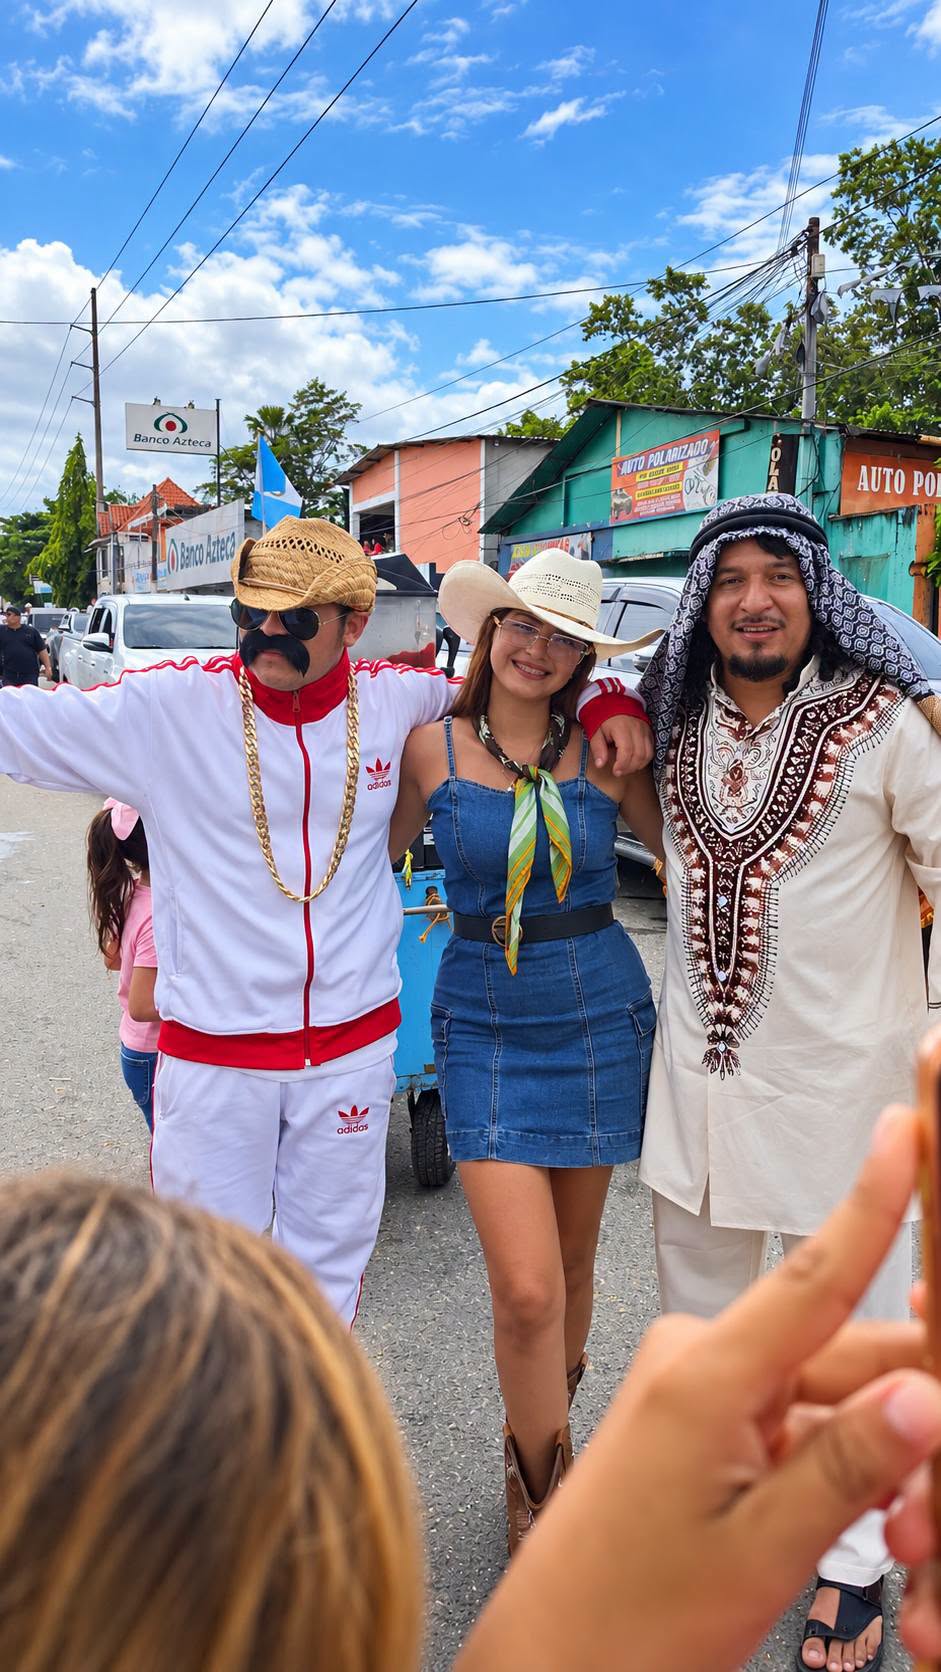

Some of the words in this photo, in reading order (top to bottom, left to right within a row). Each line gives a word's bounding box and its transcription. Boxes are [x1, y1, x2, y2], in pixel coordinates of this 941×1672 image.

[133, 433, 170, 445] Banco
[173, 436, 212, 448] Azteca
[620, 455, 646, 476] AUTO
[647, 438, 709, 469] POLARIZADO
[857, 464, 906, 495] AUTO
[180, 541, 204, 570] Banco
[205, 531, 236, 565] Azteca
[367, 779, 392, 791] adidas
[336, 1123, 369, 1135] adidas
